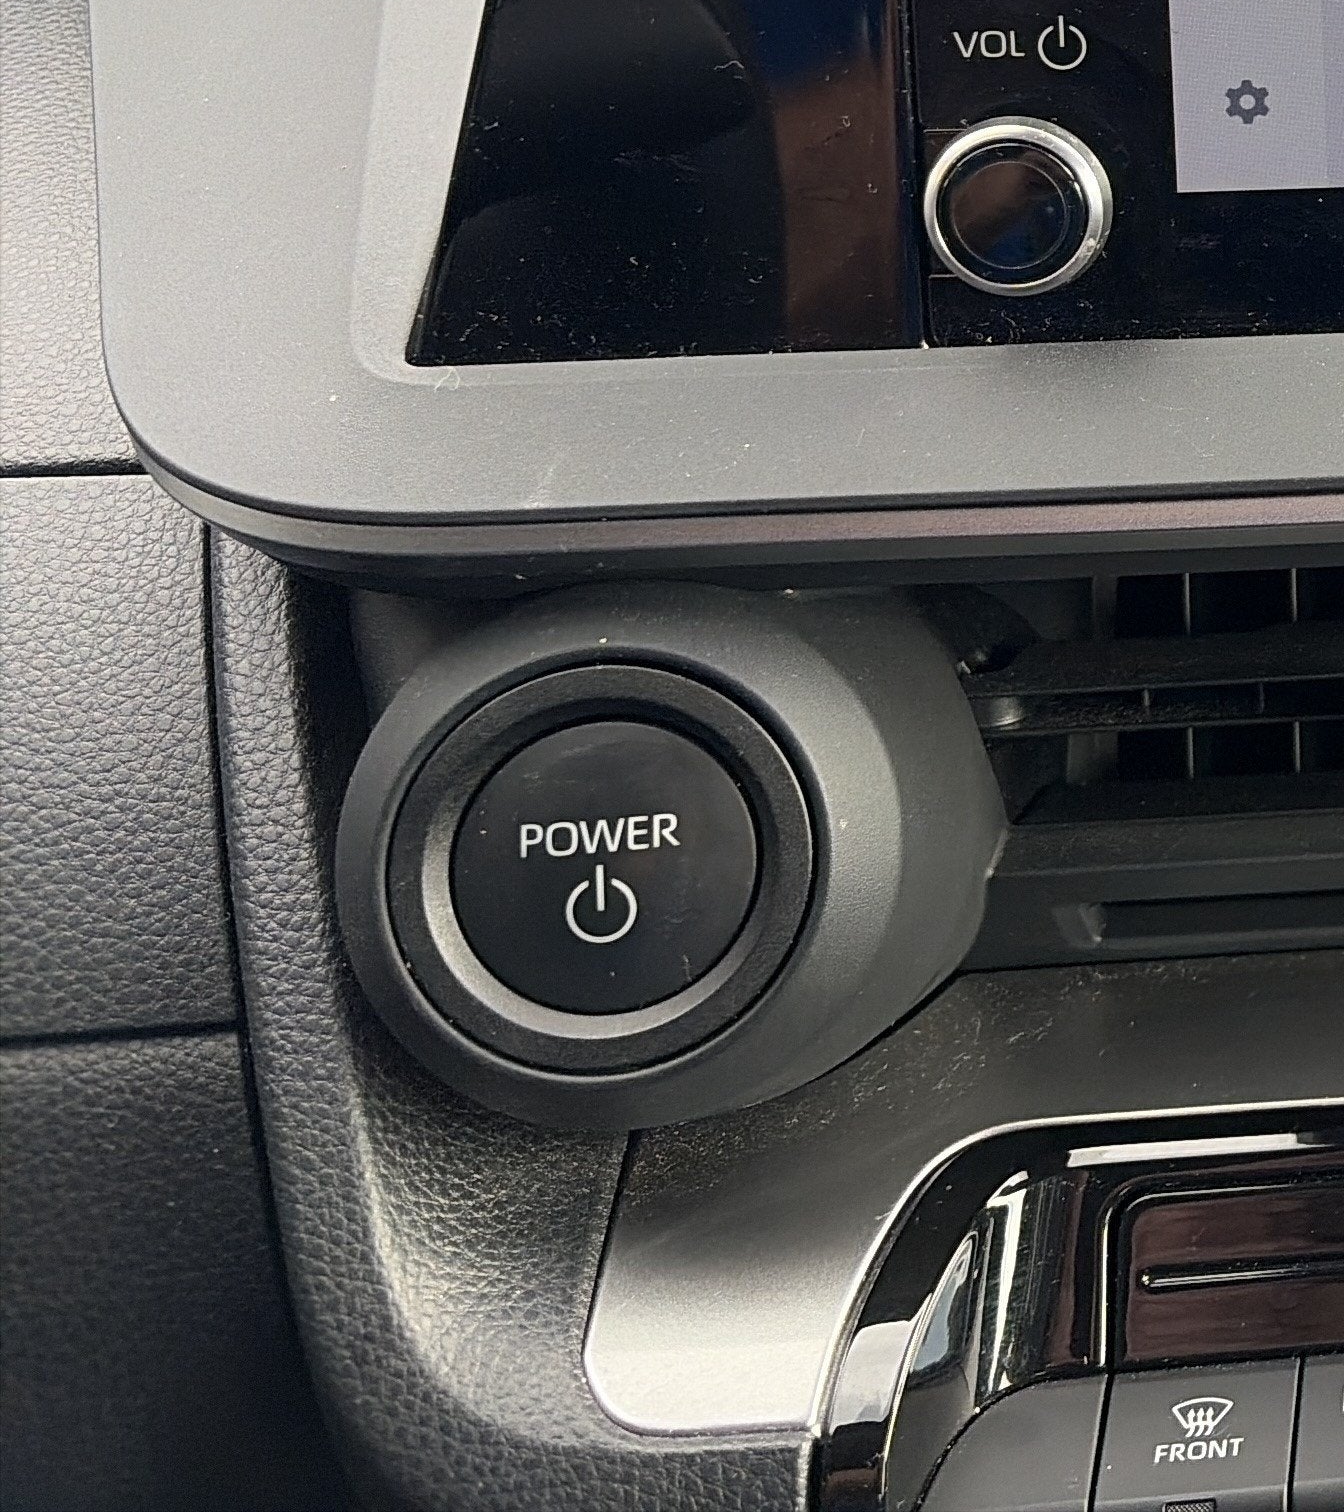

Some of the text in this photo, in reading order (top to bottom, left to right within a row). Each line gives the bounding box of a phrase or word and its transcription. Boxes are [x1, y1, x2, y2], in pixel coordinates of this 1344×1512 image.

[952, 30, 1026, 58] VOL
[520, 813, 681, 858] POWER
[1153, 1435, 1245, 1464] FRONT
